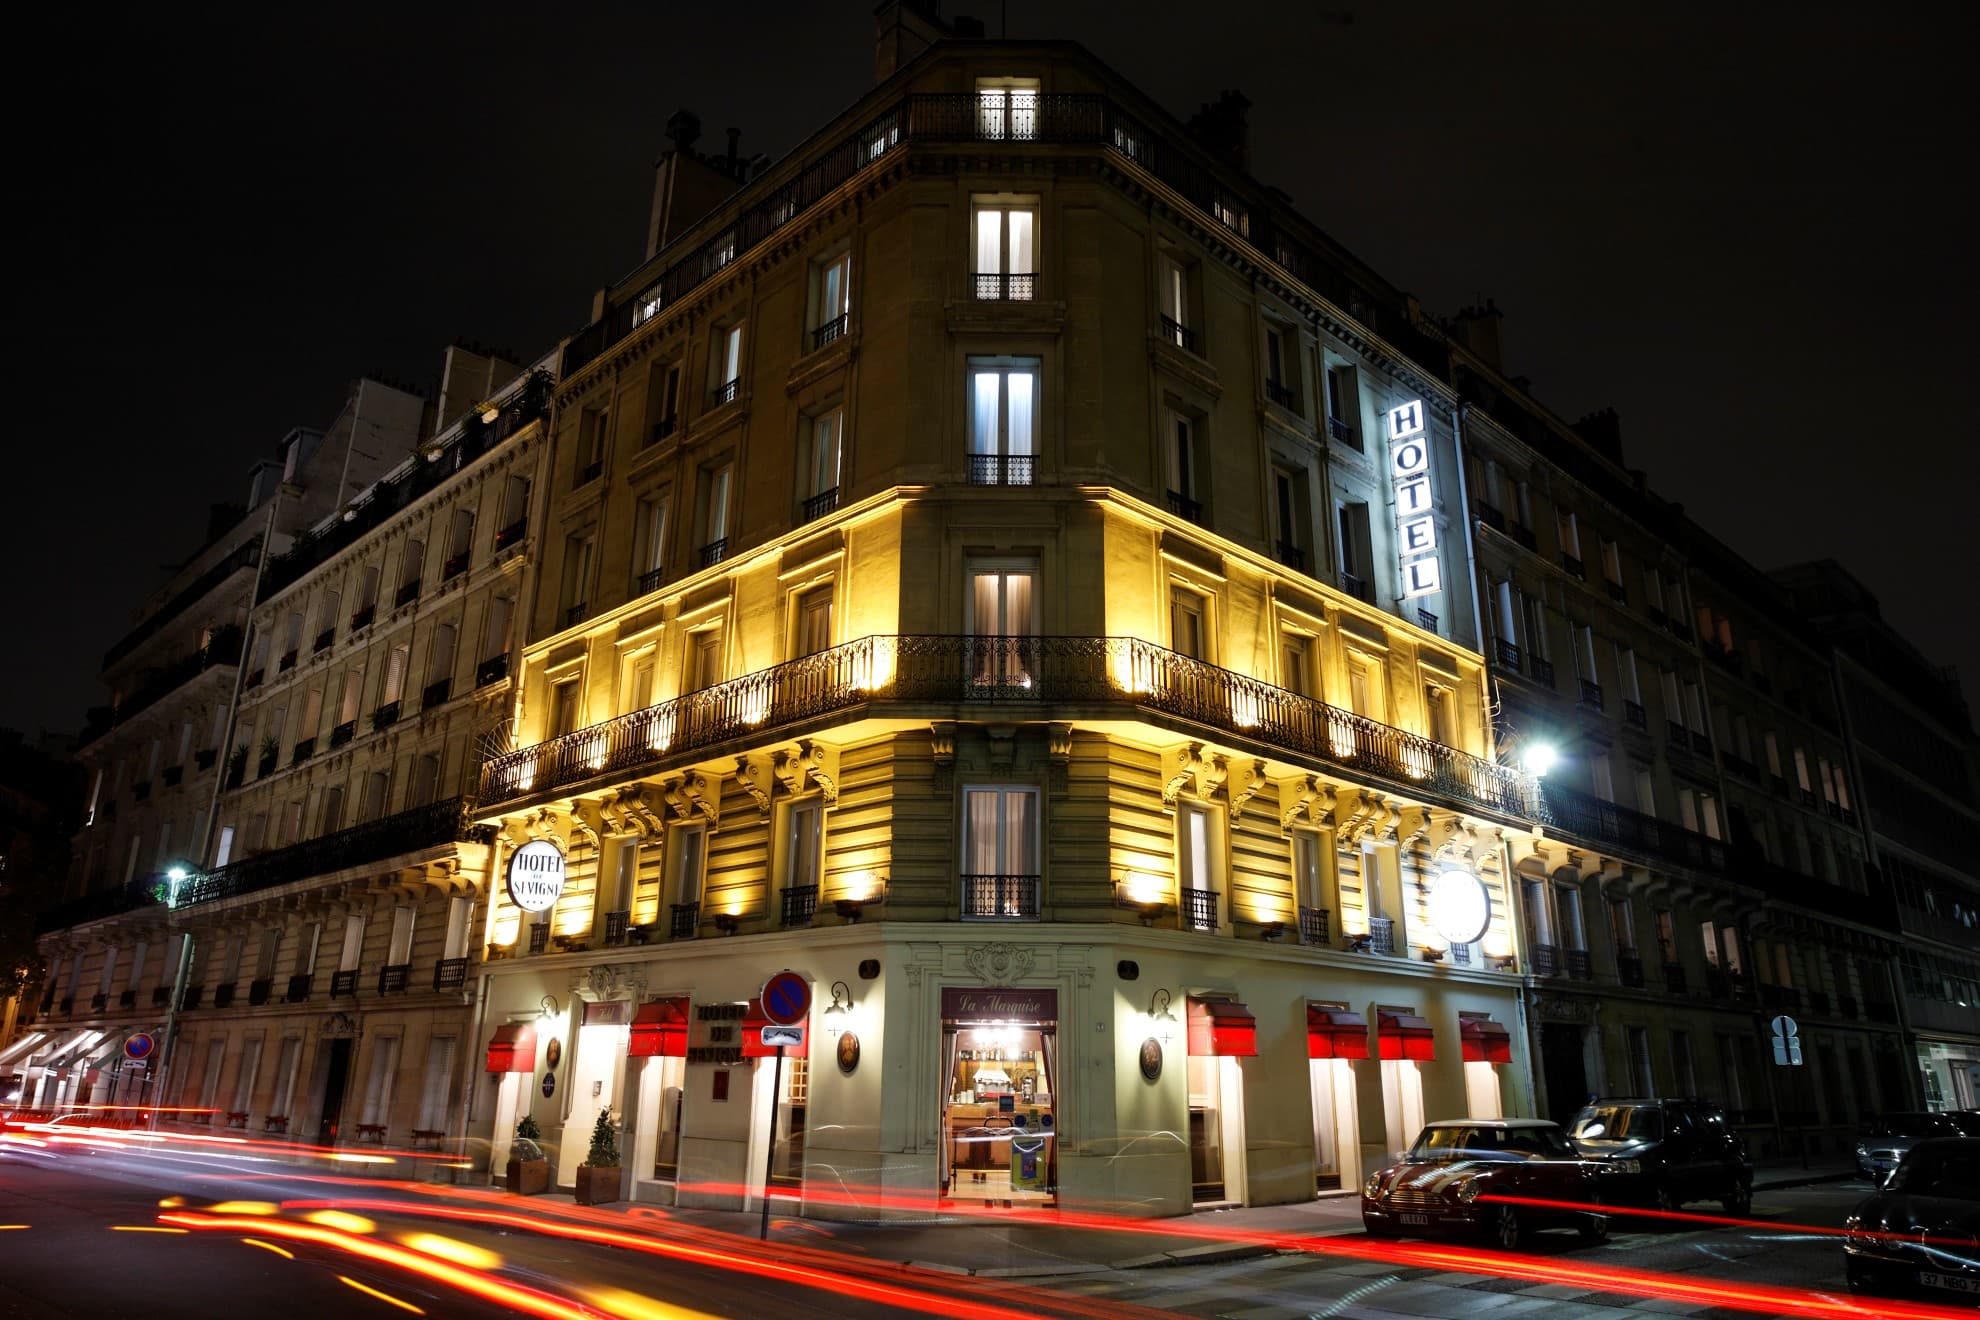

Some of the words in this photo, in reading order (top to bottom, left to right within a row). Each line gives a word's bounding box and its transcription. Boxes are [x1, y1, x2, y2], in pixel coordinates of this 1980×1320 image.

[1394, 404, 1433, 592] HOTEL
[519, 853, 562, 872] HOTEL
[983, 994, 1041, 1016] Marquise
[1923, 1272, 1938, 1285] 37
